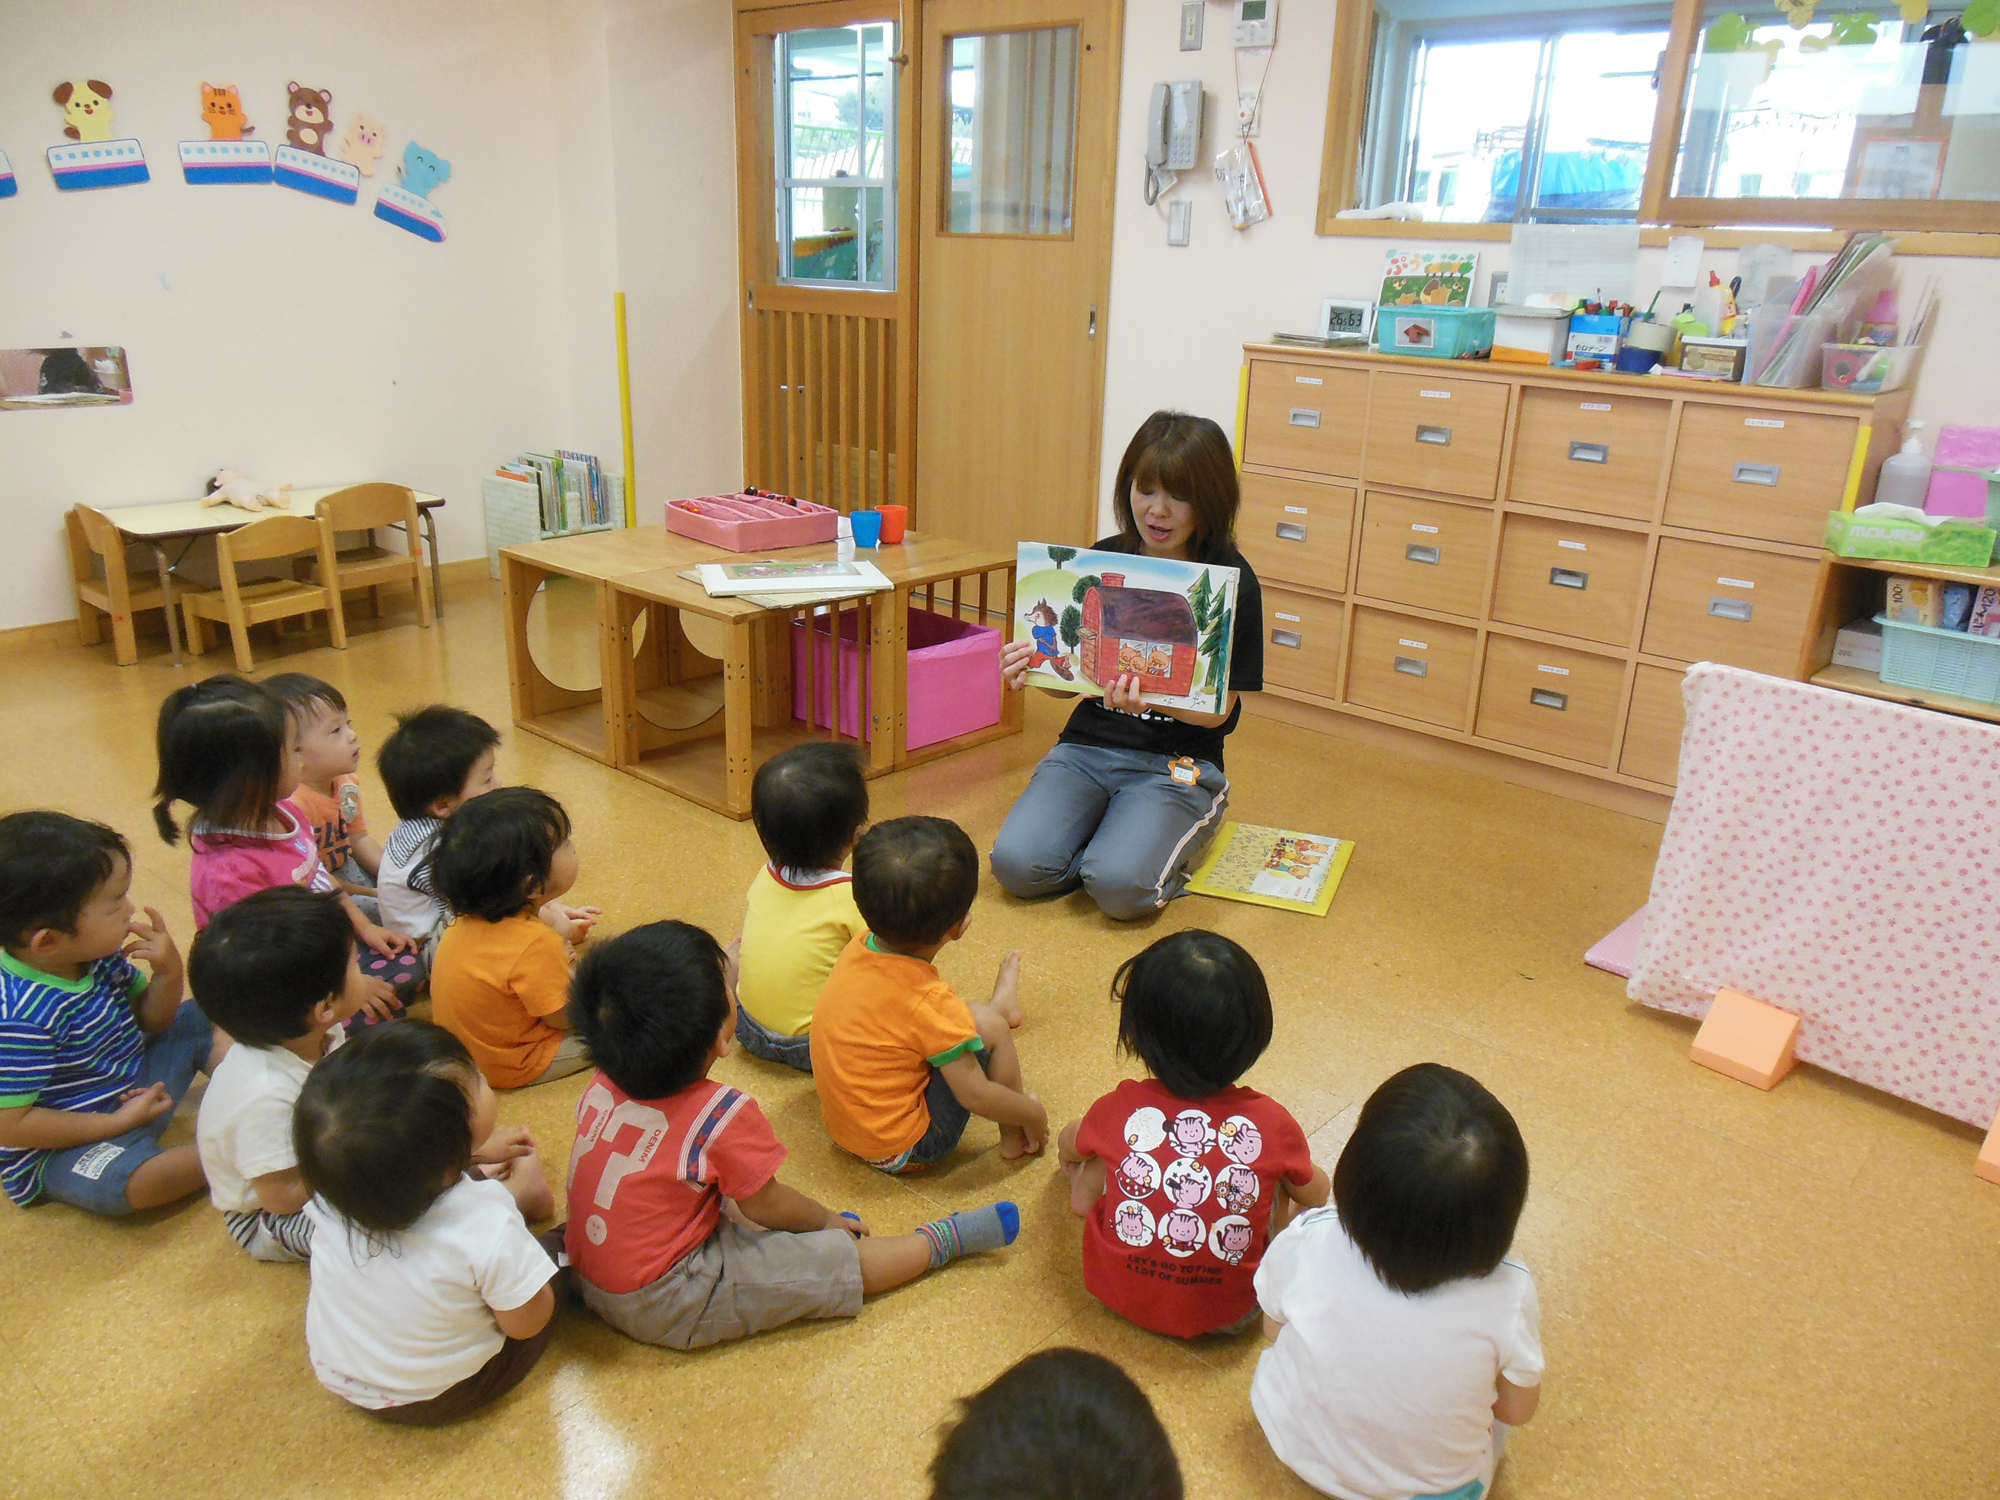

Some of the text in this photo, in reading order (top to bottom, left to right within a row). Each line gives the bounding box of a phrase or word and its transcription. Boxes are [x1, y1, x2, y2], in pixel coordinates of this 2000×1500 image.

[638, 1129, 662, 1163] DENIM
[1135, 1266, 1156, 1277] LOT
[1158, 1272, 1172, 1281] OF
[1175, 1276, 1222, 1285] SUMMER
[1160, 1261, 1177, 1271] GO
[1180, 1265, 1194, 1274] TO
[1196, 1265, 1222, 1275] FIND
